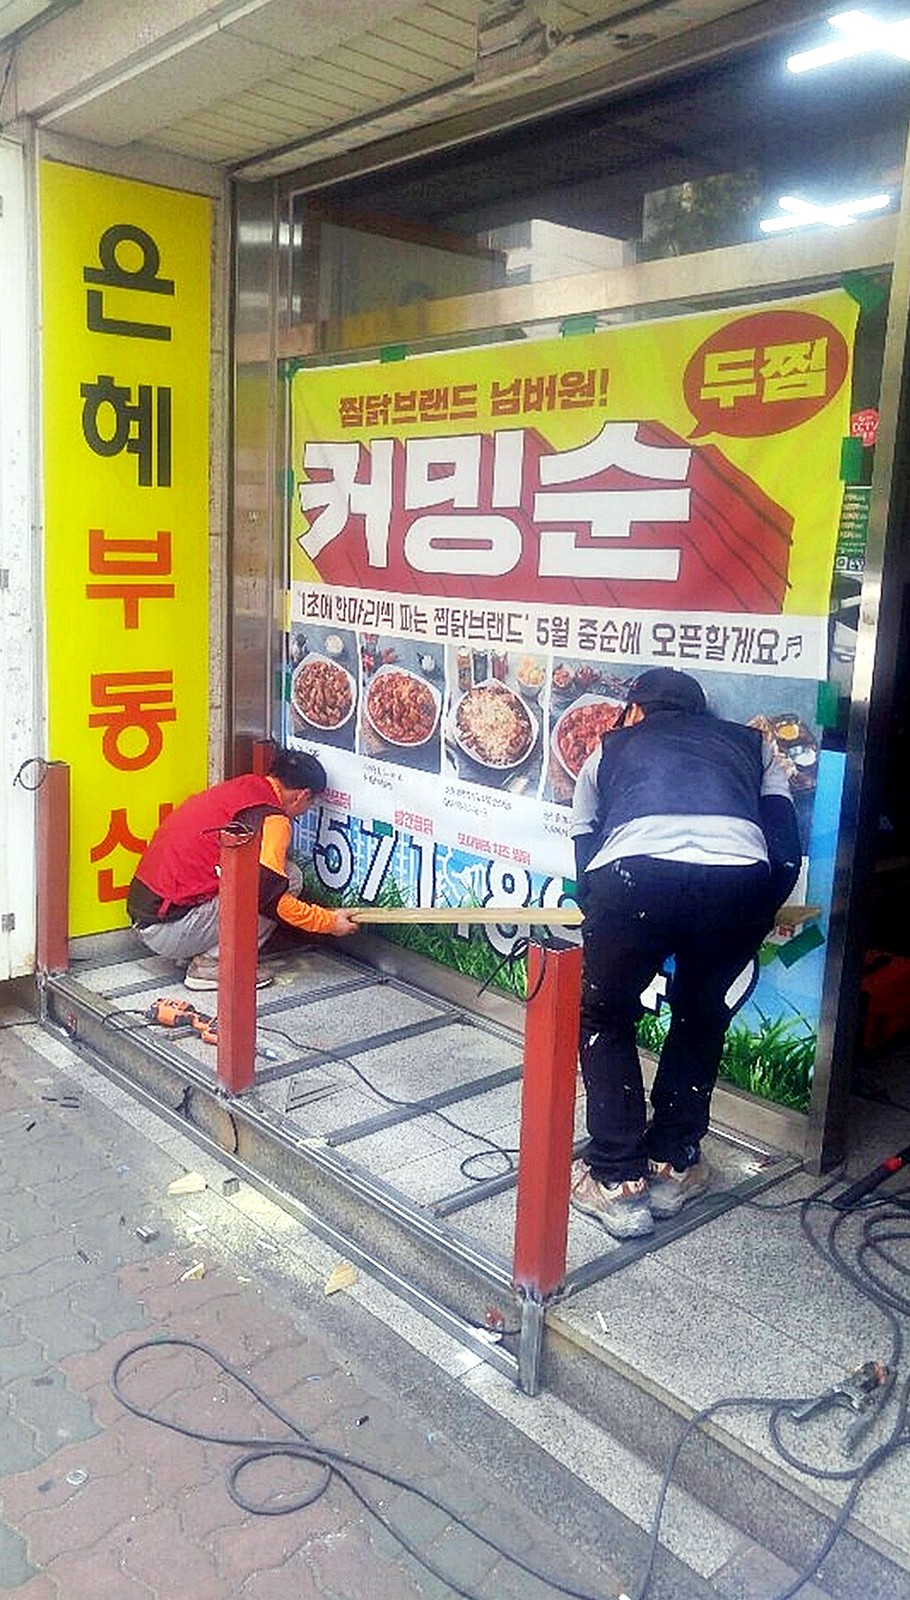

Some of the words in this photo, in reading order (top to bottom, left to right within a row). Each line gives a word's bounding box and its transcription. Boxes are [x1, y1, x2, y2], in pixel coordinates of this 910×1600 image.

[339, 383, 478, 429] 찜닭브랜드
[490, 368, 610, 416] 넘버원!
[700, 337, 829, 409] 두찜
[296, 421, 692, 582] 커밍순
[399, 603, 428, 634] 파는
[536, 615, 570, 649] 5월
[577, 616, 642, 655] 중순에
